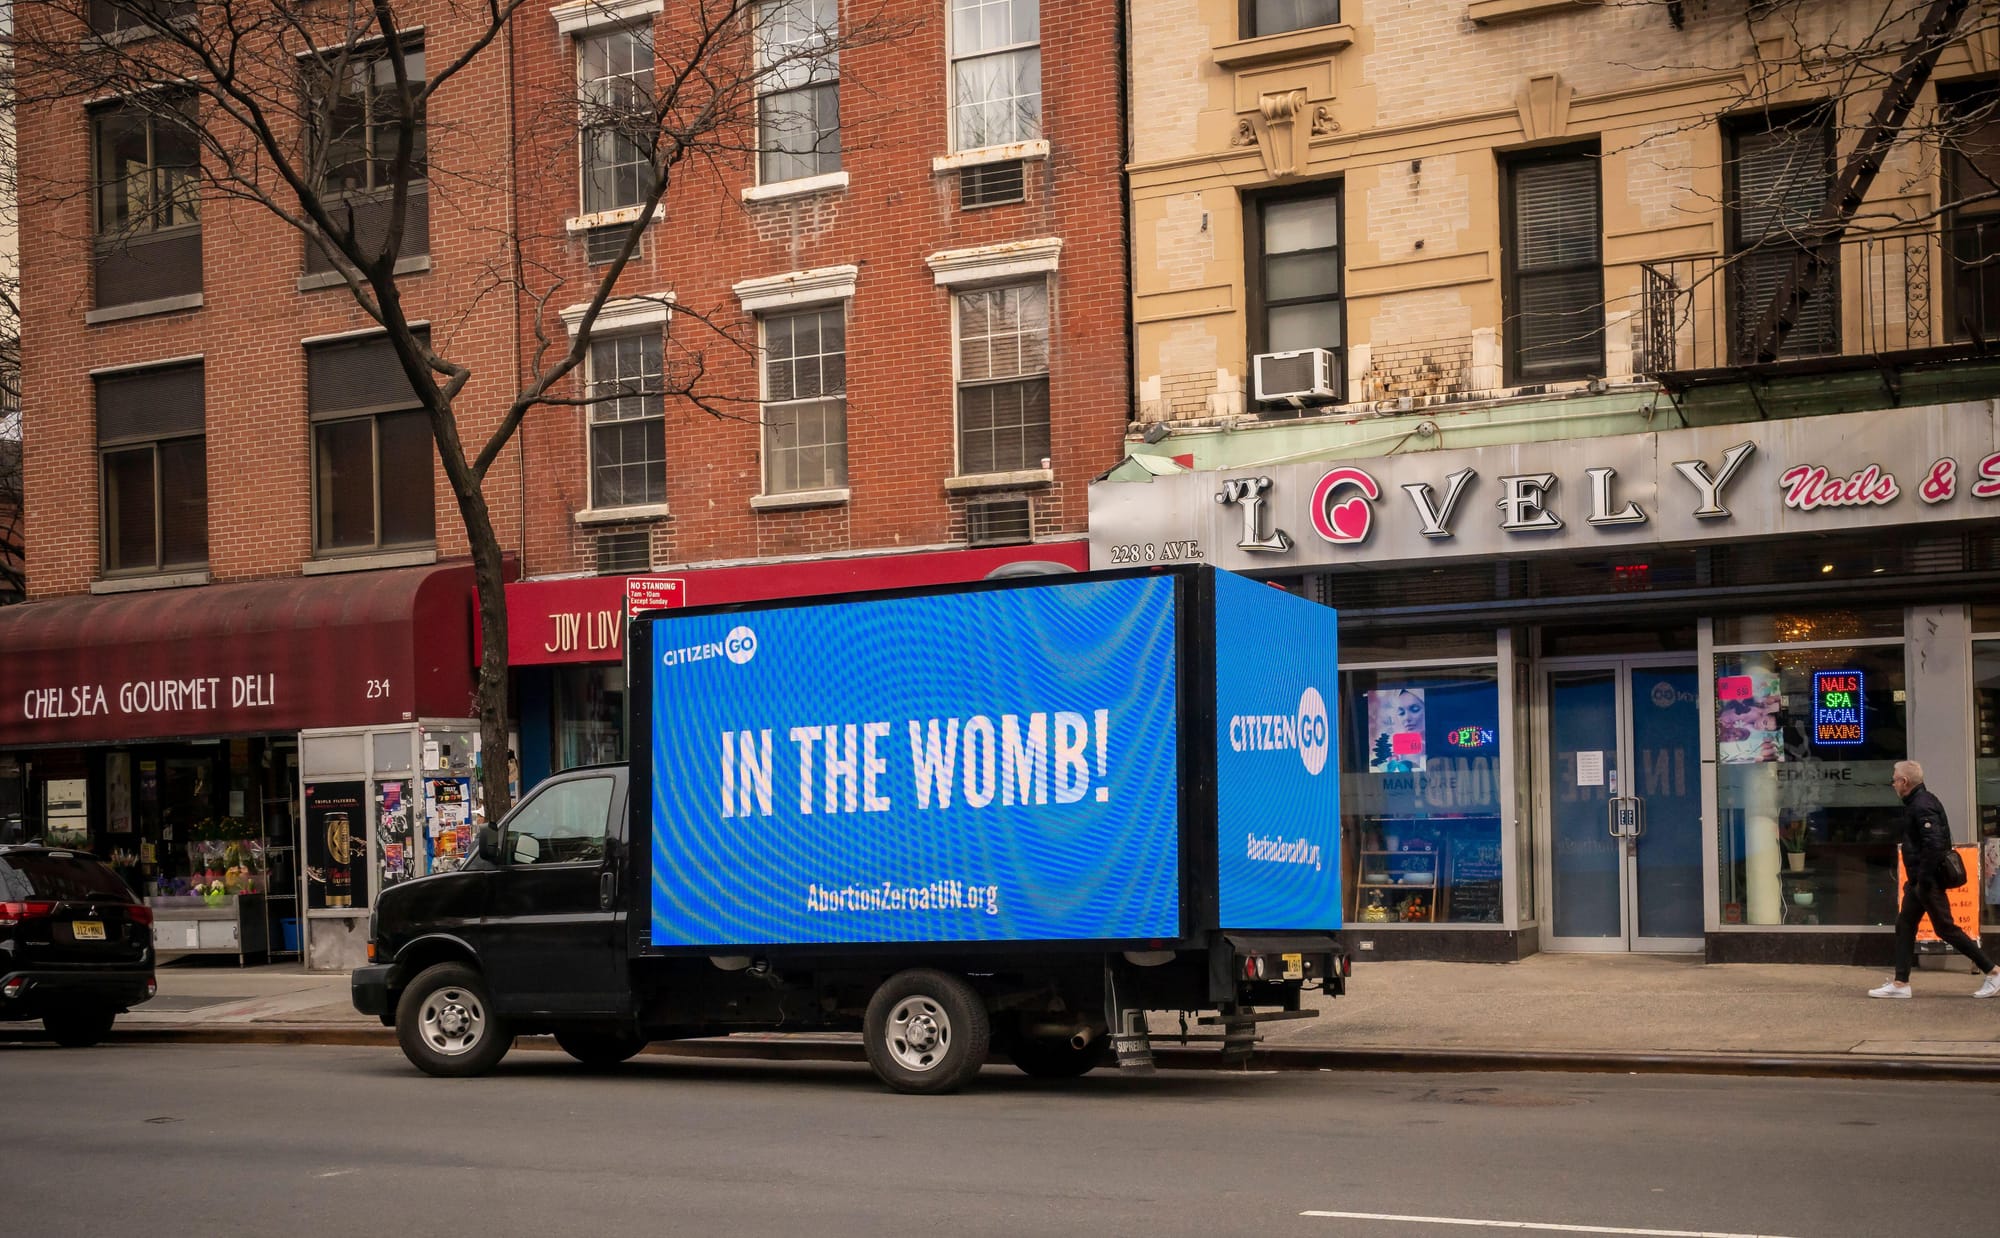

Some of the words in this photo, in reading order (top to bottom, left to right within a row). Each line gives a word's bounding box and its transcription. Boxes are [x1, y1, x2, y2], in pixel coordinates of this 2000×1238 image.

[1779, 463, 1900, 511] Nails
[1918, 456, 1958, 504] &
[1237, 439, 1758, 553] LOVELY
[1111, 543, 1141, 564] 228
[1144, 542, 1156, 561] 8
[1160, 539, 1204, 561] AVE.
[630, 582, 641, 590] NO
[642, 582, 676, 590] STANDING
[650, 598, 668, 606] Sunday
[545, 613, 581, 653] JOY
[366, 678, 391, 699] 234
[1820, 677, 1857, 692] NAILS
[24, 684, 109, 720] CHELSEA
[120, 677, 220, 714] GOURMET
[232, 673, 275, 708] DELI
[1825, 692, 1852, 708] SPA
[1819, 708, 1858, 724] FACIAL
[1447, 729, 1494, 745] OPEN
[1818, 724, 1861, 740] WAXING
[721, 729, 773, 818] IN
[790, 721, 891, 815] THE
[908, 708, 1110, 810] WOMB!
[807, 879, 999, 915] AbortionZeroatUN.org
